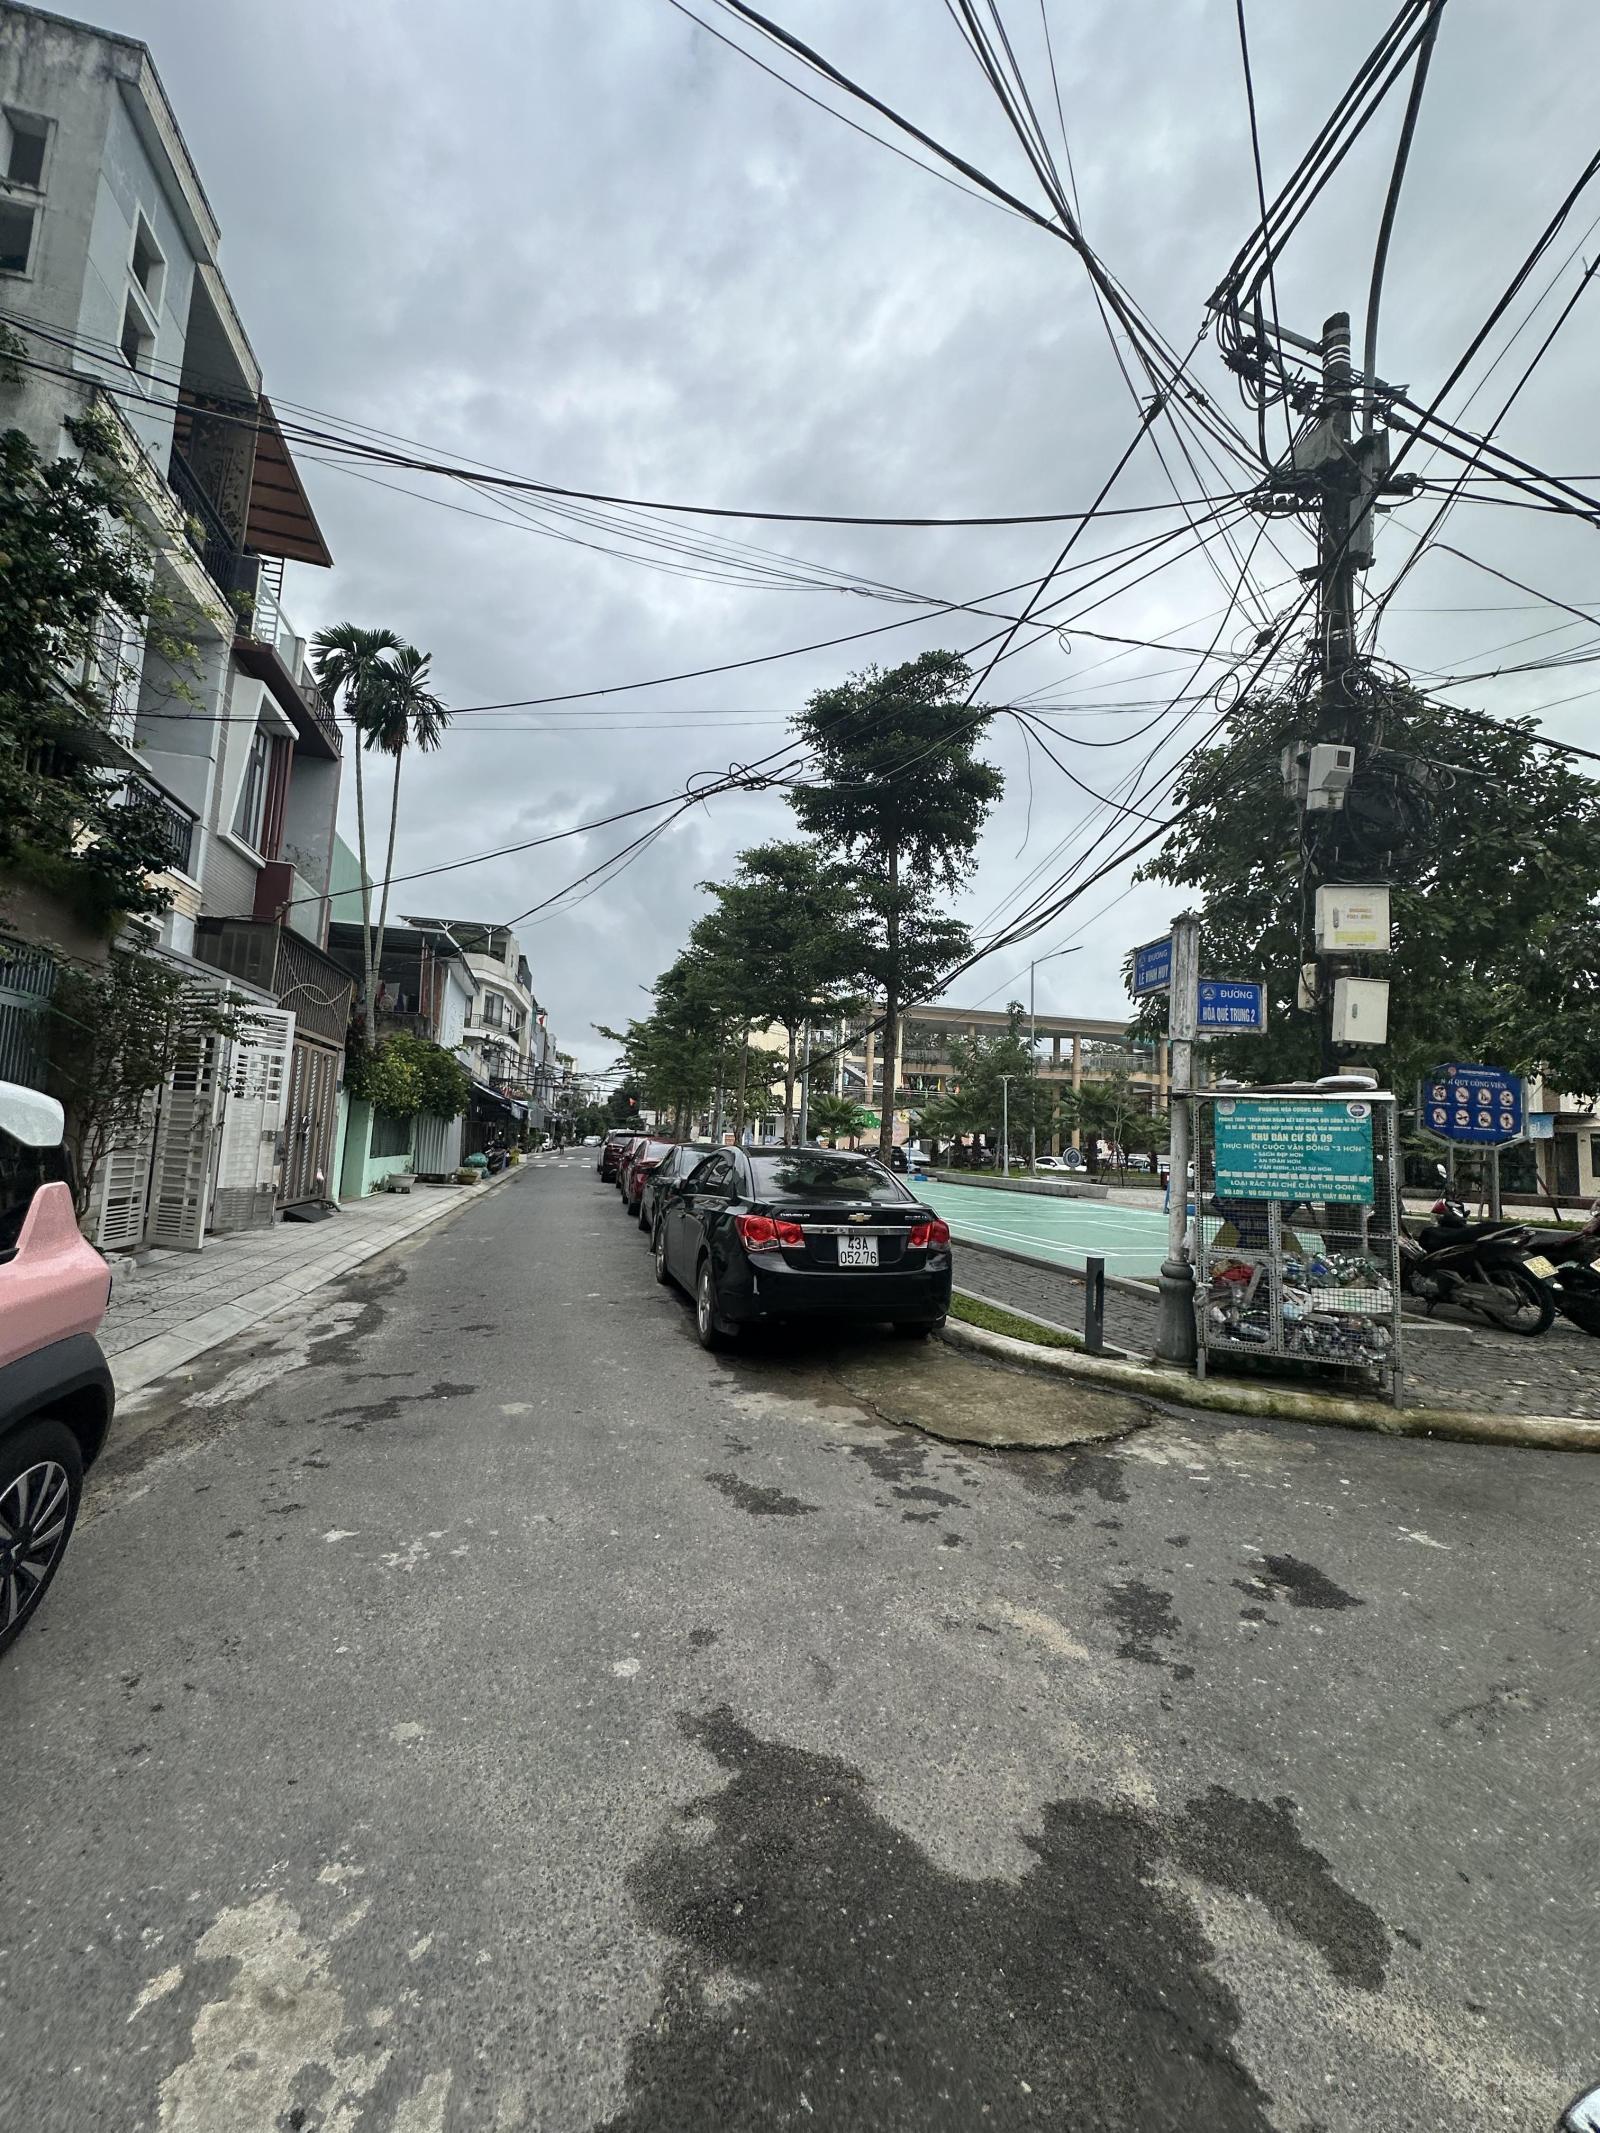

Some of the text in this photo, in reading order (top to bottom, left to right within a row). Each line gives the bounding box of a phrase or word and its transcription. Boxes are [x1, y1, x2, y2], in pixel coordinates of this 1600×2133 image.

[1148, 950, 1168, 962] ĐƯỜNG
[1139, 969, 1145, 985] LÊ
[1220, 988, 1253, 999] ĐƯỜNG
[1230, 1008, 1250, 1022] TRUNG
[1251, 1009, 1255, 1022] 2
[1470, 1079, 1489, 1087] CÔNG
[1252, 1132, 1333, 1143] KHU DÂN CƯ SỐ 09
[1262, 1143, 1285, 1151] CUỘC
[1306, 1144, 1330, 1152] ĐỘNG
[1299, 1181, 1316, 1189] CẦN
[848, 1237, 868, 1250] 43A
[840, 1252, 877, 1265] 052.76
